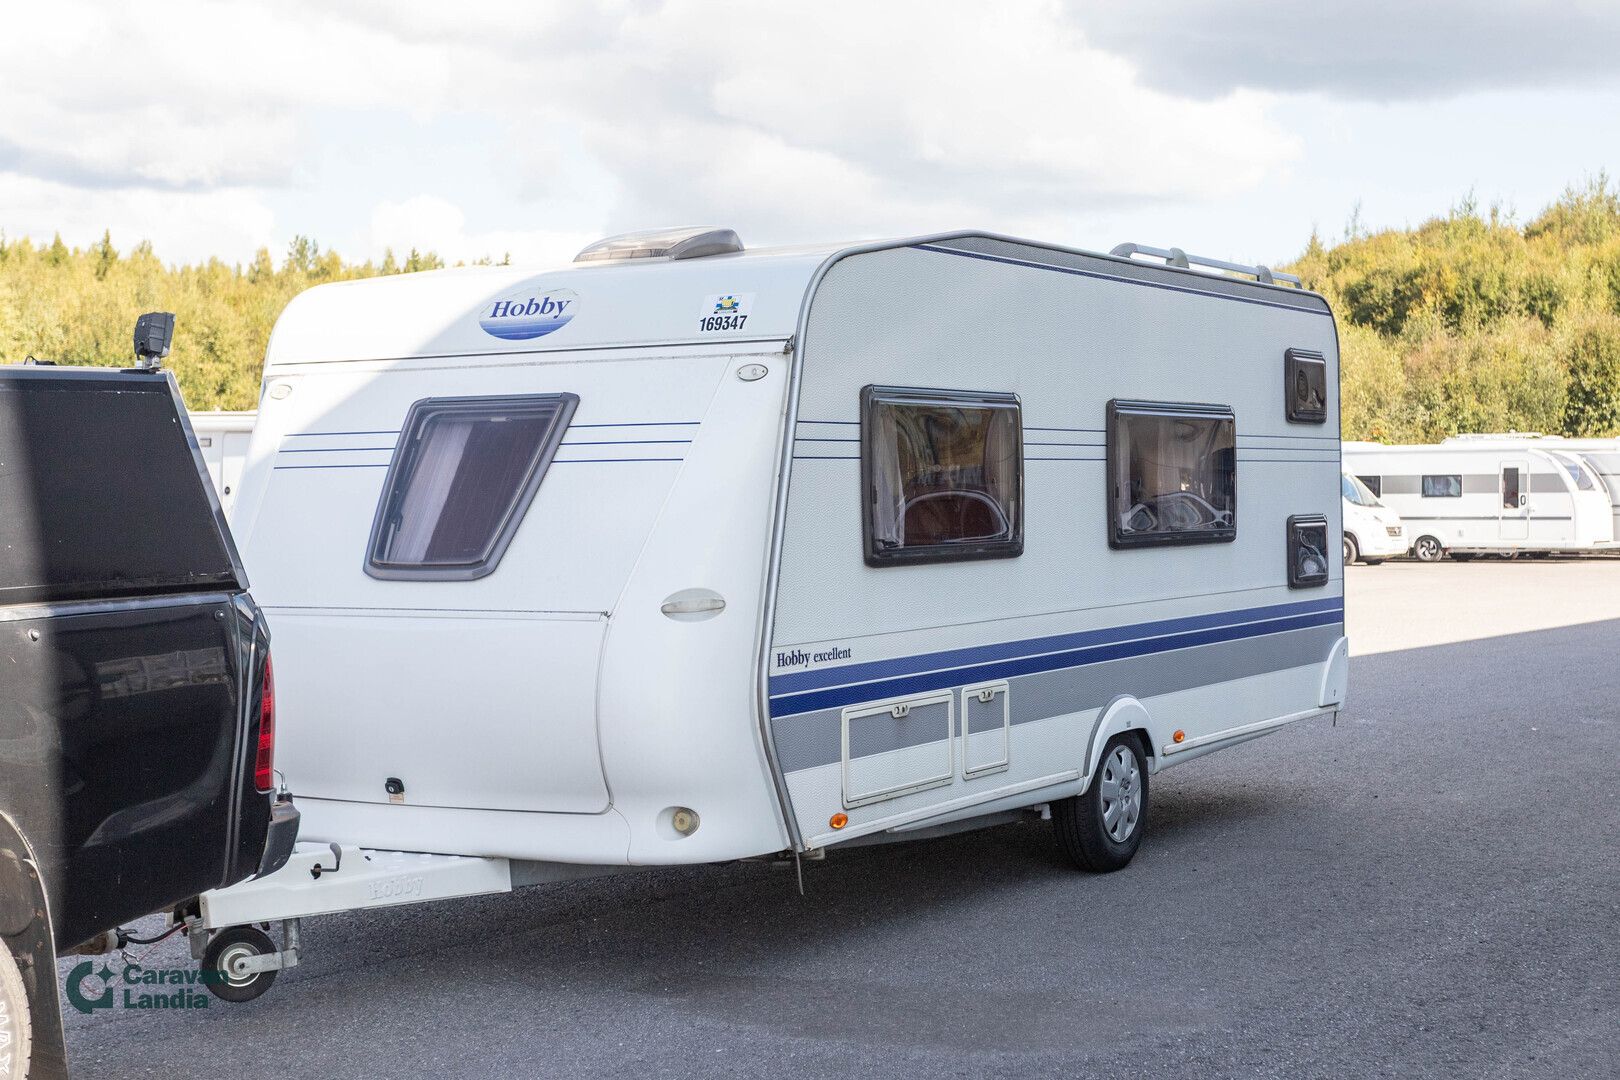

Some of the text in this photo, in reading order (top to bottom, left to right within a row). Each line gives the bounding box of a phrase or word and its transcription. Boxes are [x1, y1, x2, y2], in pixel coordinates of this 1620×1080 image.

[489, 296, 572, 319] Hobby
[699, 315, 748, 331] 169347
[777, 647, 851, 668] Hobby excellent
